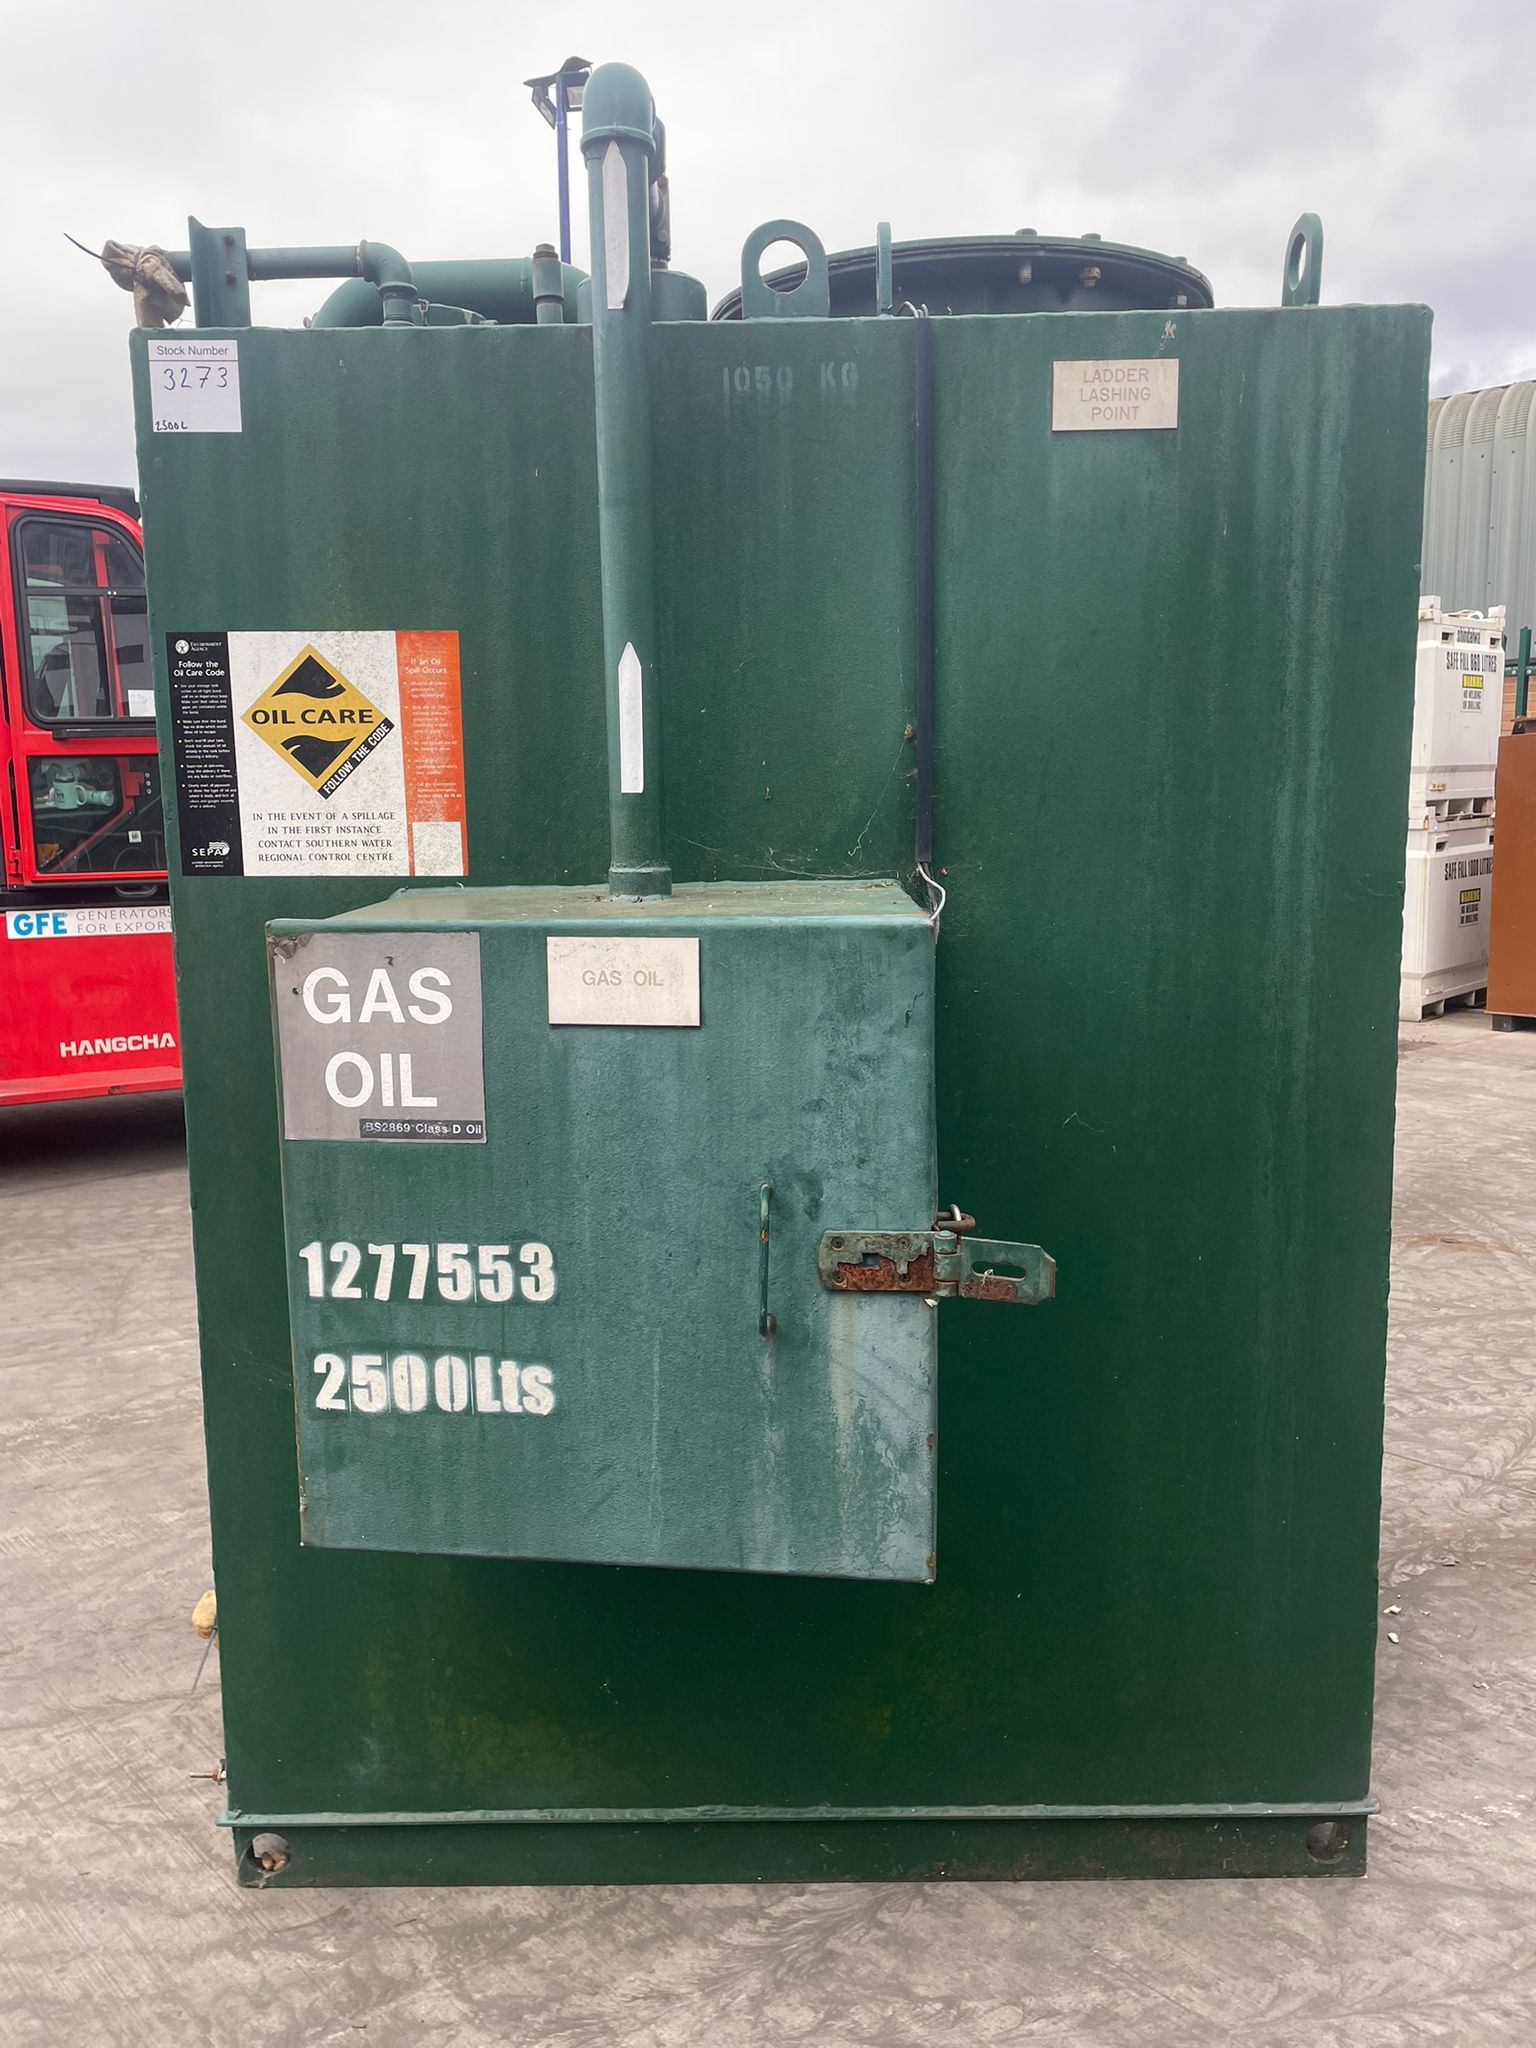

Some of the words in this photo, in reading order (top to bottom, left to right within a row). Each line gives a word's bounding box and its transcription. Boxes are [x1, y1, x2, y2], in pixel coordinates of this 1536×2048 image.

[157, 346, 185, 355] Stock
[188, 346, 228, 355] Number
[164, 367, 227, 390] 3273
[1083, 368, 1149, 383] LADDER
[1080, 387, 1150, 402] LASHING
[1092, 406, 1139, 420] POINT
[1446, 651, 1458, 670] SAFE
[1460, 653, 1469, 670] FILL
[1482, 655, 1497, 672] LITRES
[251, 709, 296, 725] OIL
[300, 709, 374, 724] CARE
[322, 761, 353, 795] FOLLOW
[352, 744, 369, 762] THE
[368, 722, 390, 746] CODE
[252, 813, 263, 821] IN
[267, 813, 286, 821] THE
[290, 812, 322, 820] EVENT
[326, 812, 337, 820] OF
[342, 812, 348, 820] A
[352, 812, 395, 820] SPILLAGE
[268, 826, 278, 834] IN
[283, 826, 301, 834] THE
[305, 826, 332, 834] FIRST
[336, 825, 382, 833] INSTANCE
[192, 848, 223, 856] SEPA
[258, 840, 301, 848] CONTACT
[306, 840, 357, 848] SOUTHERN
[258, 854, 303, 862] REGIONAL
[308, 853, 351, 861] CONTROL
[356, 853, 394, 861] CENTRE
[1445, 862, 1456, 880] SAFE
[1458, 860, 1467, 878] FILL
[14, 912, 68, 936] GFE
[77, 922, 107, 934] FOR
[582, 970, 622, 986] GAS
[633, 970, 664, 986] OIL
[303, 967, 453, 1025] GAS
[59, 1032, 176, 1058] HANGCHA
[325, 1052, 438, 1108] OIL
[365, 1122, 411, 1133] BS2869
[415, 1122, 448, 1134] Class
[453, 1124, 461, 1134] D
[466, 1124, 482, 1134] Oil
[298, 1241, 556, 1302] 1277553
[313, 1353, 556, 1416] 2500Lts
